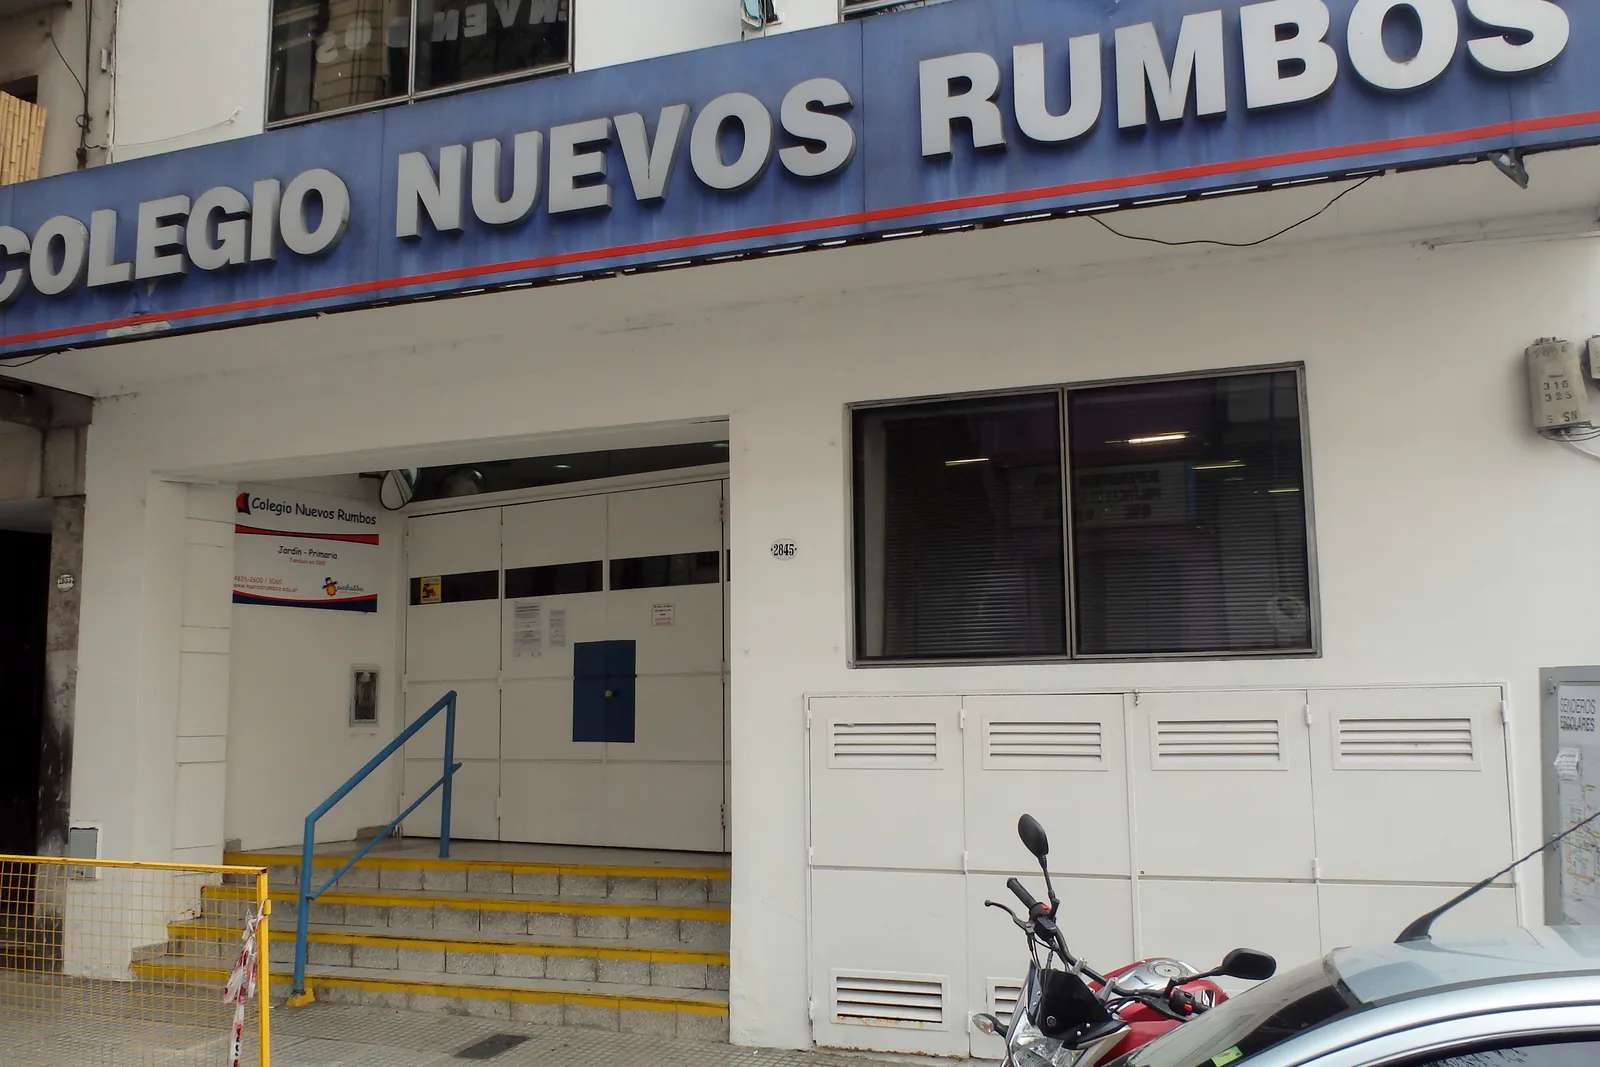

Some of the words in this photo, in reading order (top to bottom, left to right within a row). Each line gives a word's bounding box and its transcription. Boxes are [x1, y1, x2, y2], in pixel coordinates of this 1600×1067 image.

[395, 78, 857, 241] NUEVOS
[918, 0, 1570, 160] RUMBOS
[252, 498, 292, 516] Colegio
[295, 503, 334, 520] Nuevos
[337, 509, 376, 525] Rumbos
[308, 549, 338, 560] Primaria
[773, 543, 795, 556] 2845
[1560, 697, 1595, 714] SENDEROS
